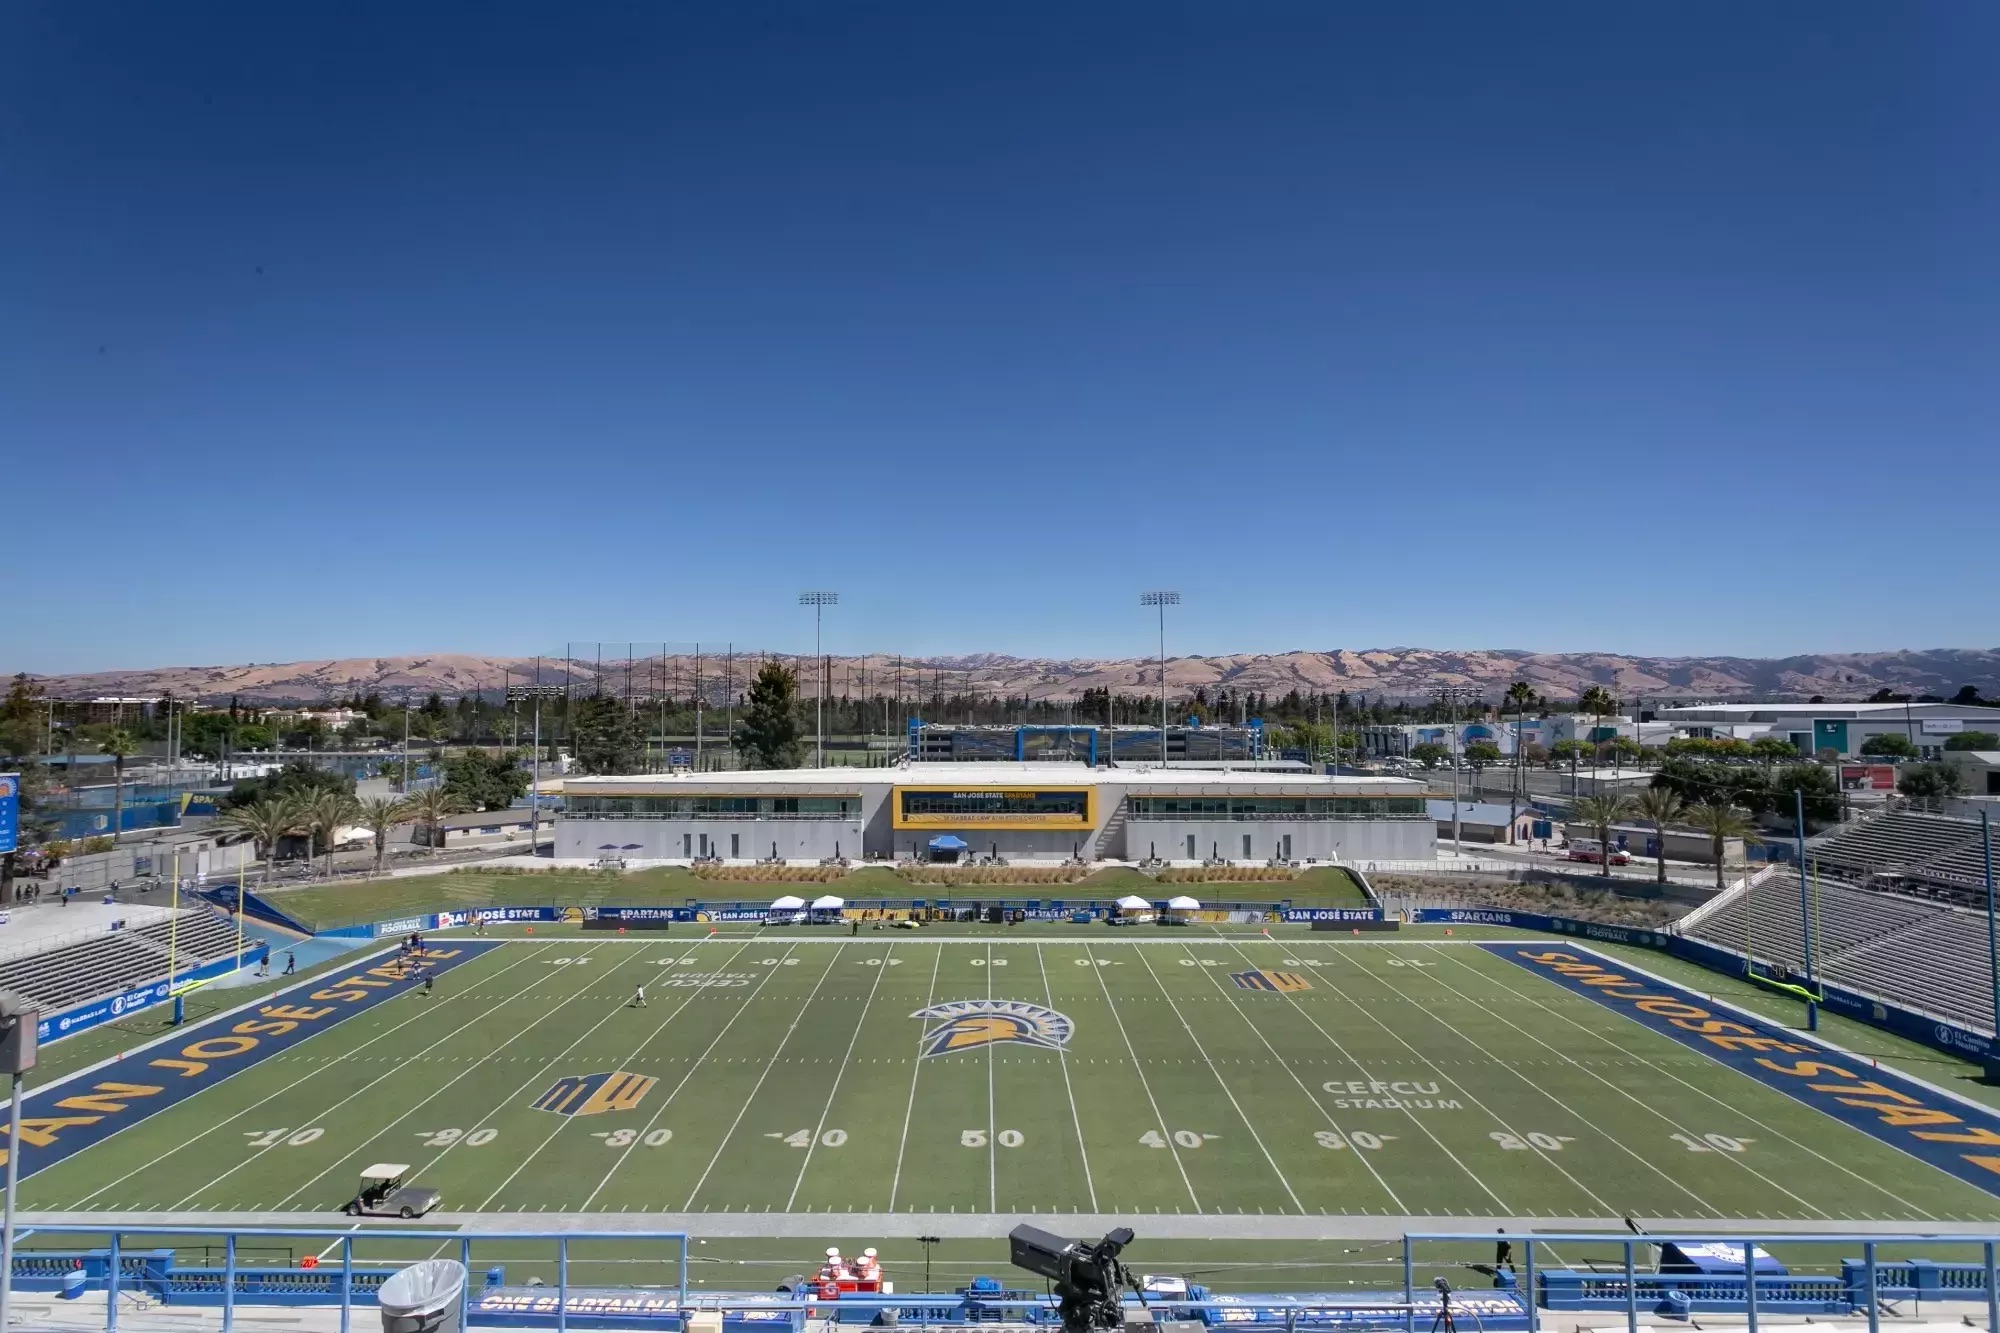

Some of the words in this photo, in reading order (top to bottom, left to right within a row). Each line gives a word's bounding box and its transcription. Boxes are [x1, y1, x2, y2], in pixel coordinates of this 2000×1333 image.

[967, 791, 984, 799] JOSÉ
[508, 909, 541, 919] STATE
[620, 909, 674, 919] SPARTANS
[722, 911, 738, 919] SAN
[738, 910, 758, 919] JOSÉ
[1288, 910, 1312, 920] SAN
[1312, 908, 1341, 920] JOSÉ
[1343, 911, 1374, 920] STATE
[1451, 911, 1512, 923] SPARTANS
[381, 921, 421, 934] FOOTBALL
[1586, 929, 1629, 942] FOOTBALL
[1517, 951, 1643, 987] SAN
[133, 988, 154, 999] Camino
[1954, 1031, 1962, 1040] El
[1962, 1034, 1990, 1049] Camino
[1954, 1039, 1980, 1053] Health
[0, 1082, 164, 1167] AN
[148, 1005, 337, 1077] JOSÉ
[309, 948, 464, 1002] STATE
[1322, 1081, 1441, 1095] CEFCU
[1335, 1098, 1463, 1109] STADIUM
[248, 1127, 325, 1147] 10
[423, 1128, 499, 1147] 20
[604, 1128, 673, 1147] 30
[783, 1128, 848, 1148] 40
[960, 1129, 1025, 1148] 50
[1138, 1130, 1202, 1149] 40
[1313, 1130, 1384, 1150] 30
[1488, 1131, 1565, 1151] 20
[1670, 1132, 1748, 1152] 10
[480, 1296, 534, 1310] ONE
